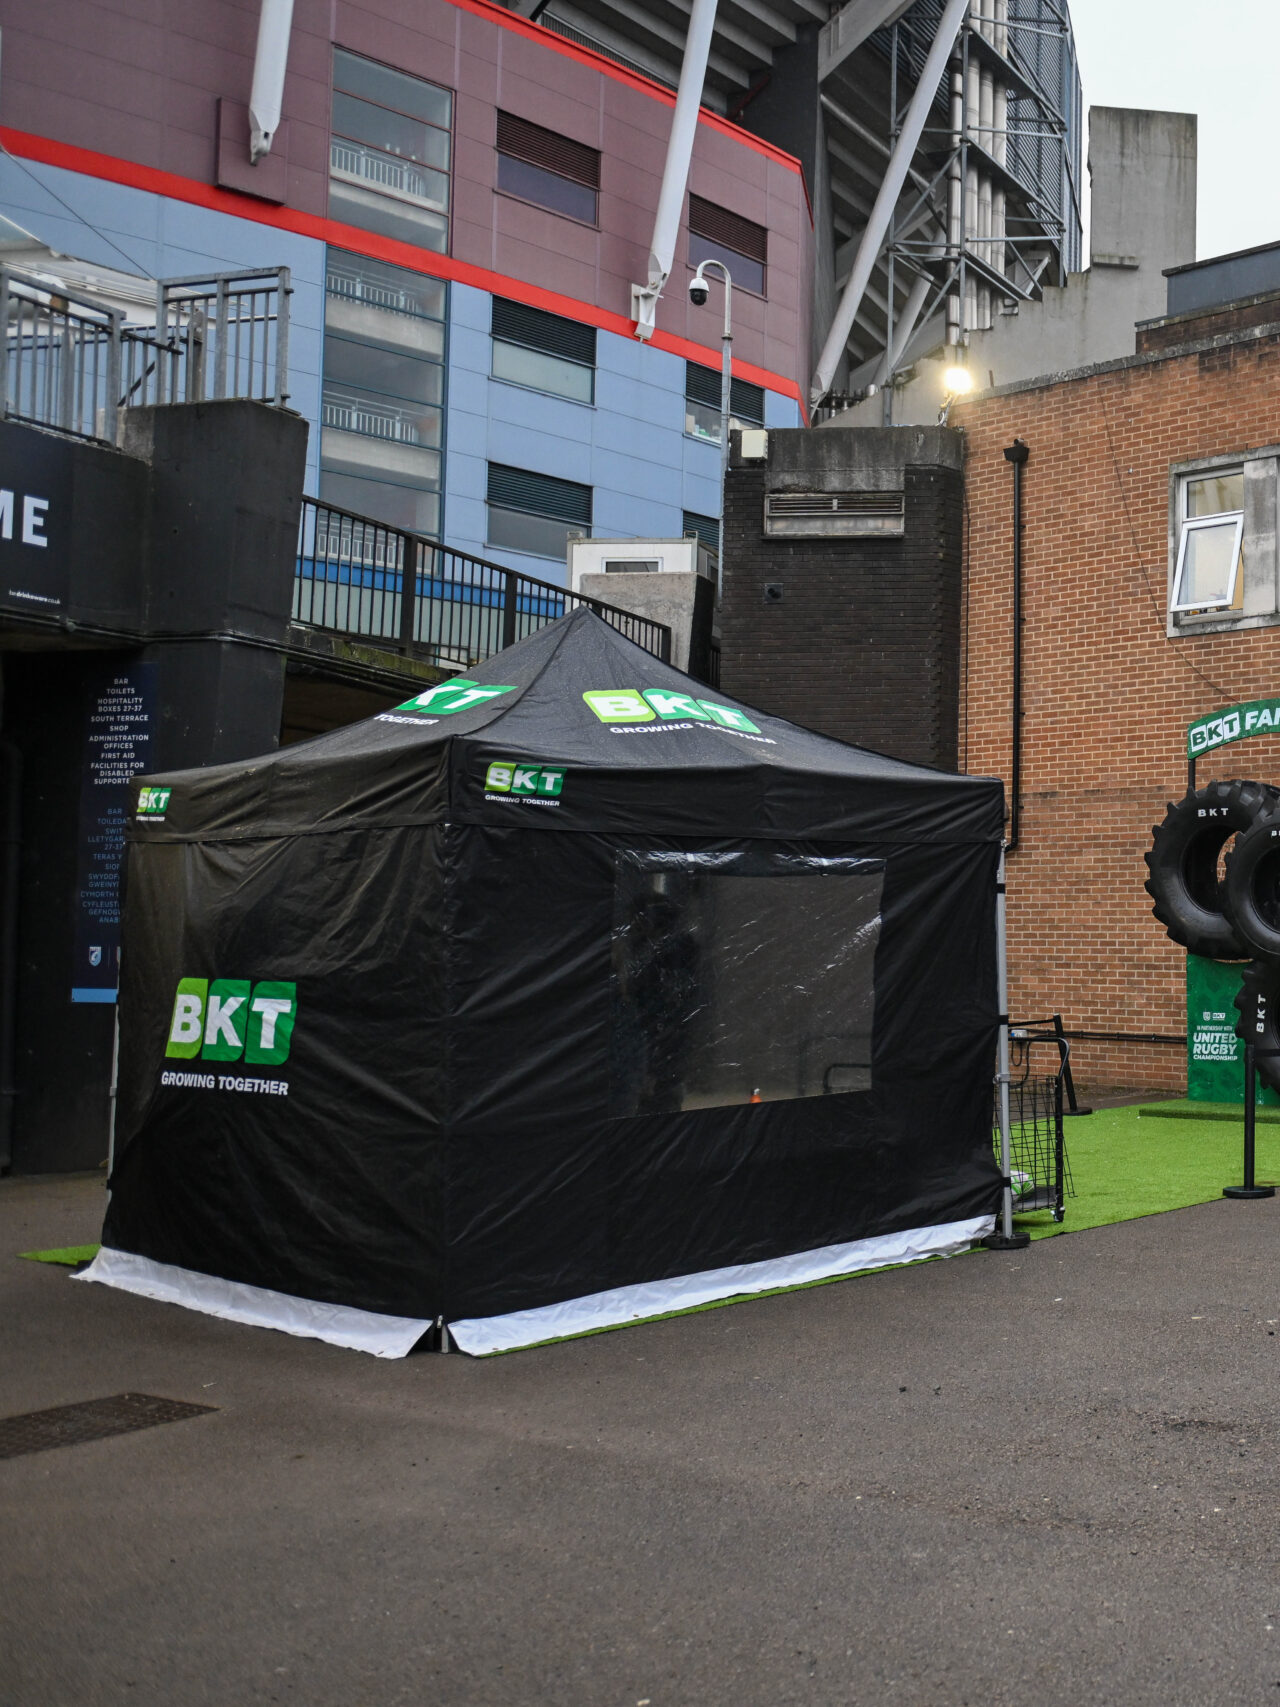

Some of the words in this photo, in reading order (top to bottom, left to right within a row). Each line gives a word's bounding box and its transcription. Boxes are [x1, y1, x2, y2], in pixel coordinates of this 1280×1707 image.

[373, 713, 440, 725] TOGETHER
[588, 695, 743, 727] BKT
[610, 723, 694, 734] GROWING
[695, 722, 778, 744] TOGETHER
[1191, 712, 1241, 752] BKT
[101, 752, 120, 760] FIRST
[487, 767, 562, 791] BKT
[138, 792, 170, 809] BKT
[485, 794, 520, 804] GROWING
[522, 798, 560, 807] TOGETHER
[98, 817, 127, 825] TOILEDA
[1198, 807, 1229, 818] BKT
[169, 993, 292, 1049] BKT
[1256, 993, 1266, 1033] BKT
[1193, 1032, 1238, 1043] UNITED
[1193, 1043, 1237, 1055] RUGBY
[161, 1071, 216, 1089] GROWING
[218, 1076, 289, 1096] TOGETHER
